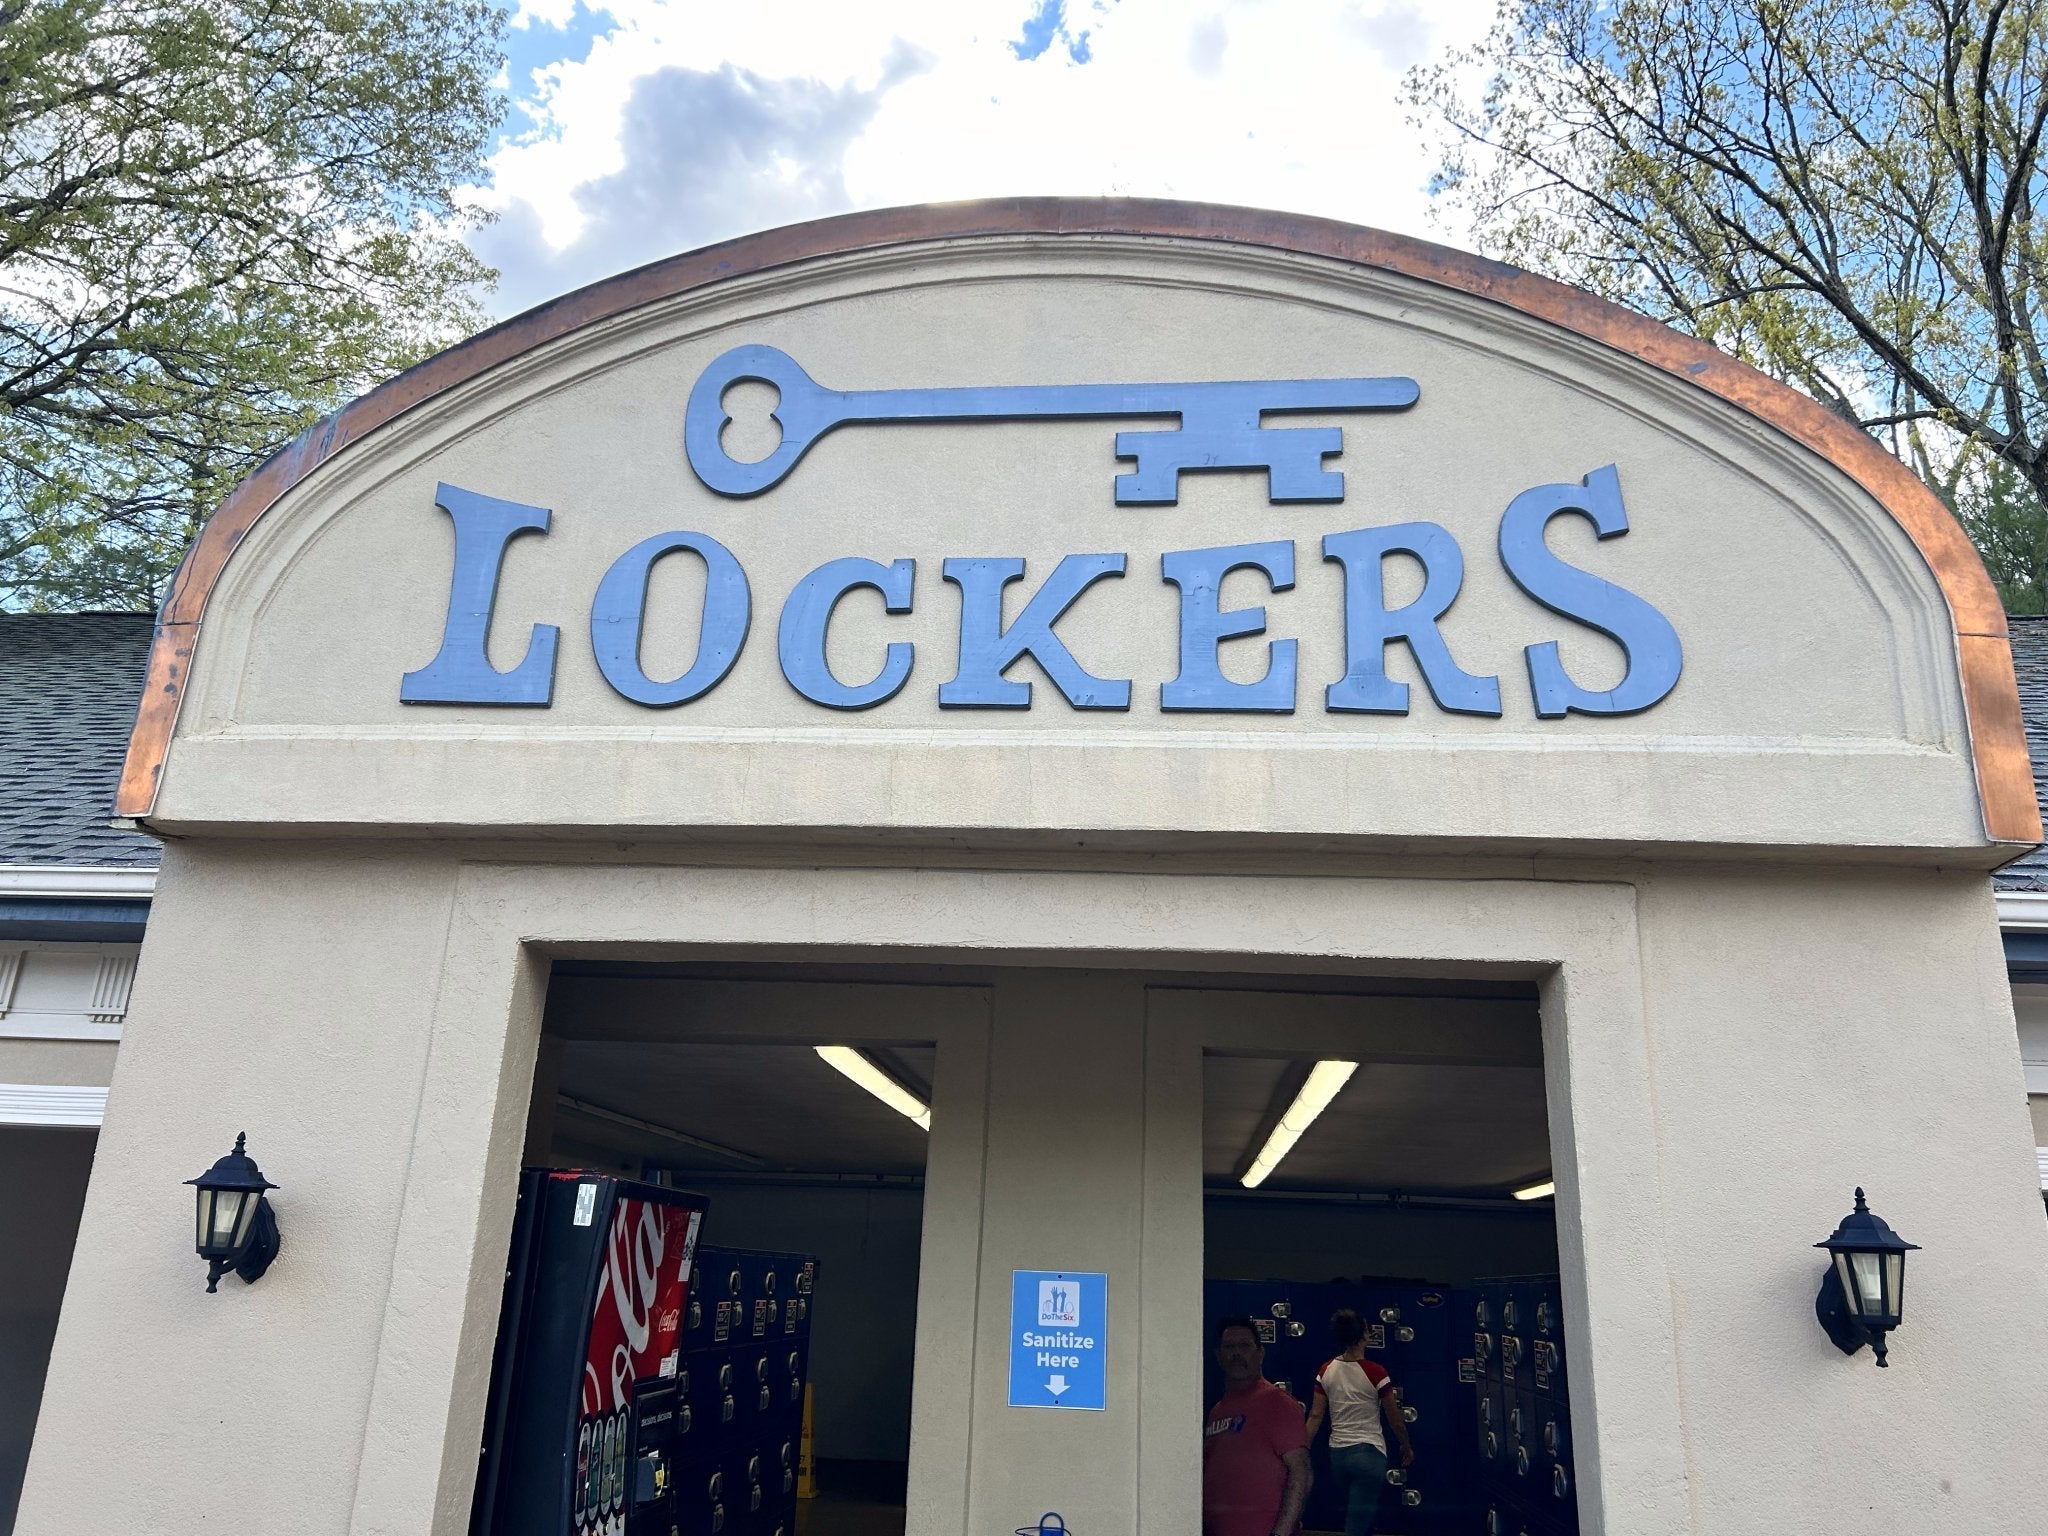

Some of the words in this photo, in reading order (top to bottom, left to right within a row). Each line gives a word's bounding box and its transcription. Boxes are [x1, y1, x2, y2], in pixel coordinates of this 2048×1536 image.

[400, 463, 1684, 720] LOCKERS
[1022, 1331, 1094, 1349] Sanitize
[1036, 1352, 1080, 1368] Here
